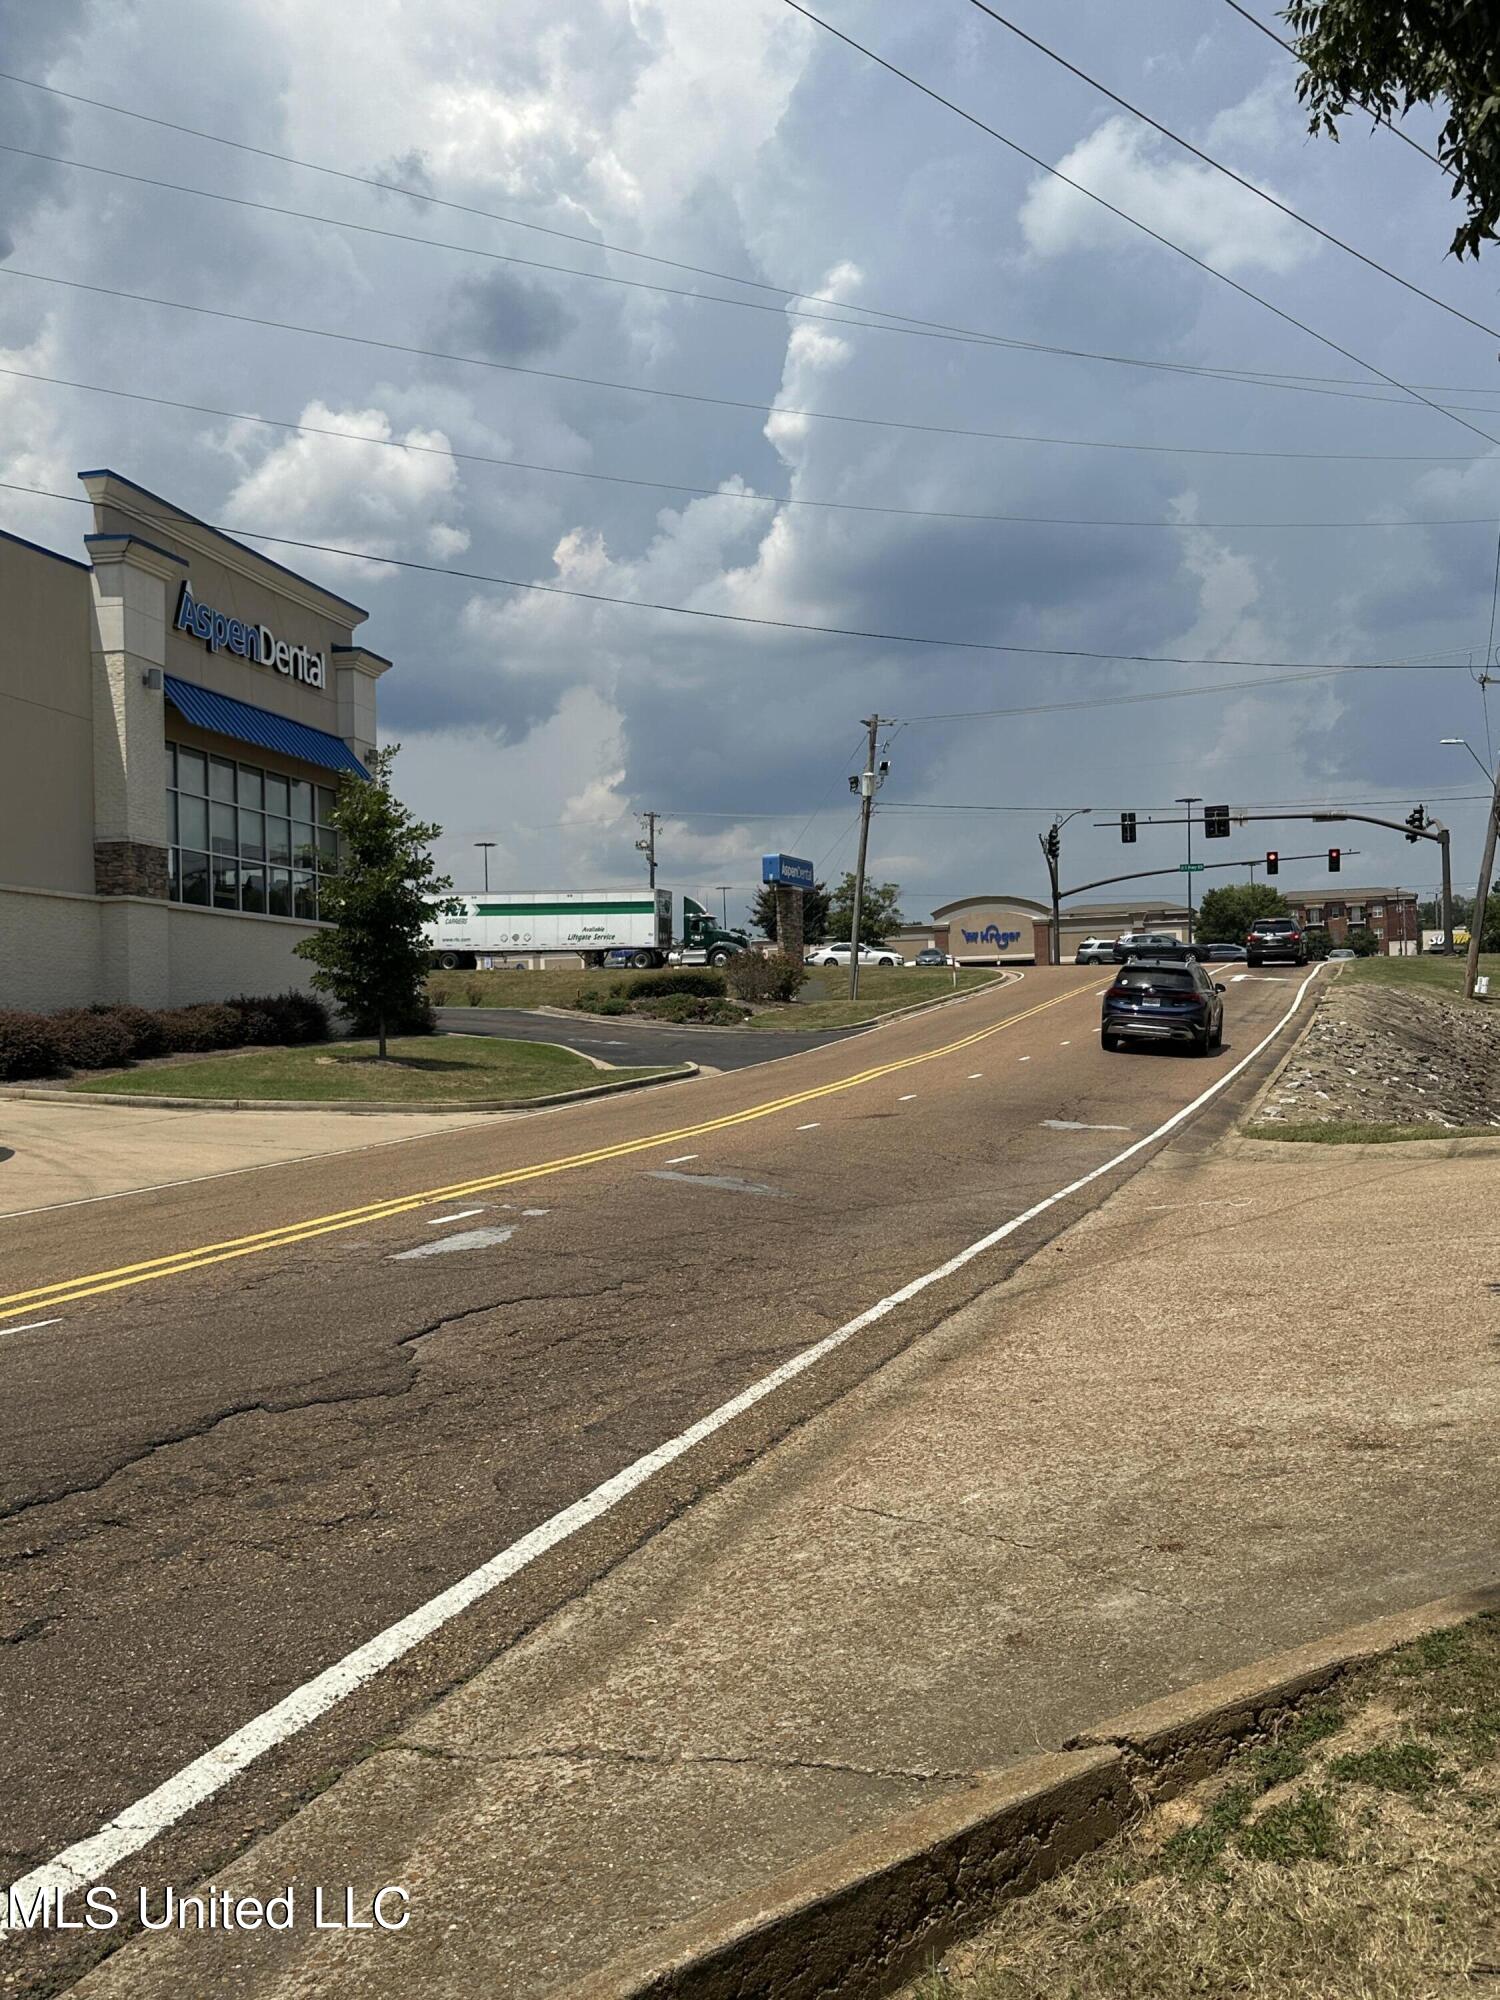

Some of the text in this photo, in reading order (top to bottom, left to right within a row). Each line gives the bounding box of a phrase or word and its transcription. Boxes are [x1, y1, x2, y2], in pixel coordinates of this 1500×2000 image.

[174, 580, 326, 689] AspenDental
[567, 933, 616, 942] Liftgate Service
[980, 924, 1021, 951] Kroger
